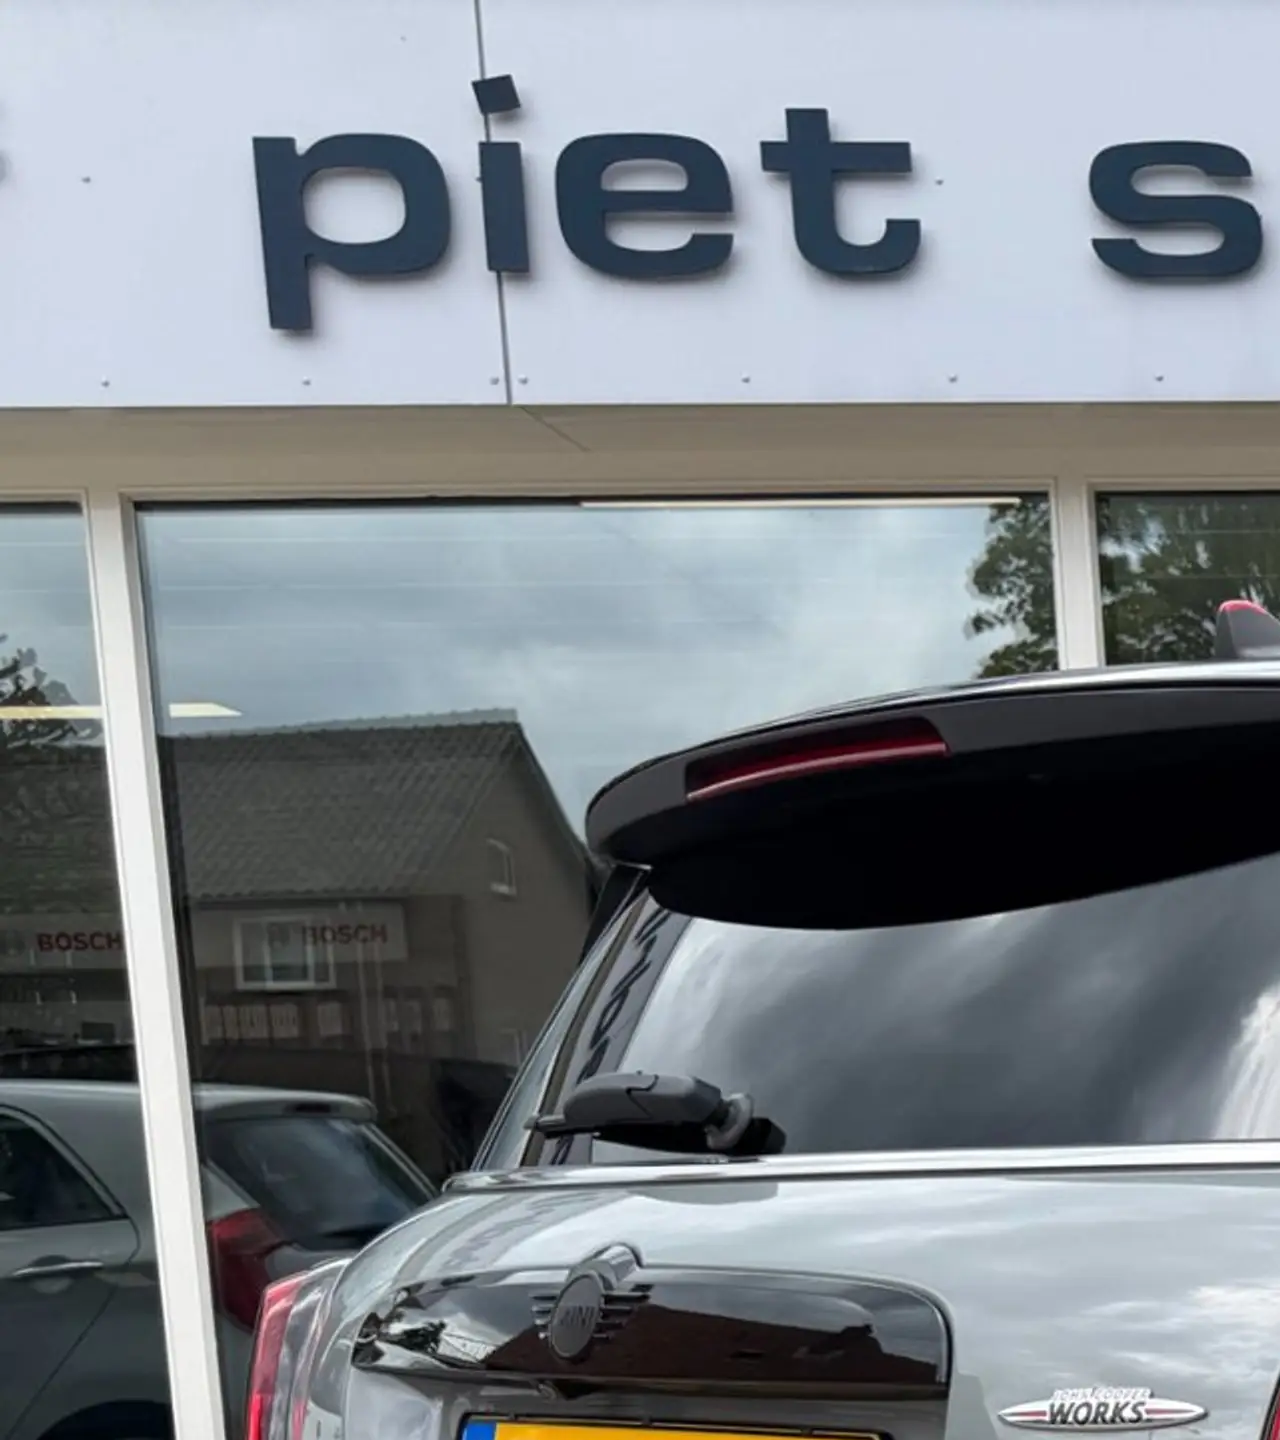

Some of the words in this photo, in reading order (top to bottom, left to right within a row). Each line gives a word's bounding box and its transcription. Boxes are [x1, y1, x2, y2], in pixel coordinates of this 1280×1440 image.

[252, 75, 920, 331] piet
[37, 931, 124, 953] BOSCH
[303, 923, 389, 946] BOSCH
[1049, 1400, 1147, 1426] WORKS
